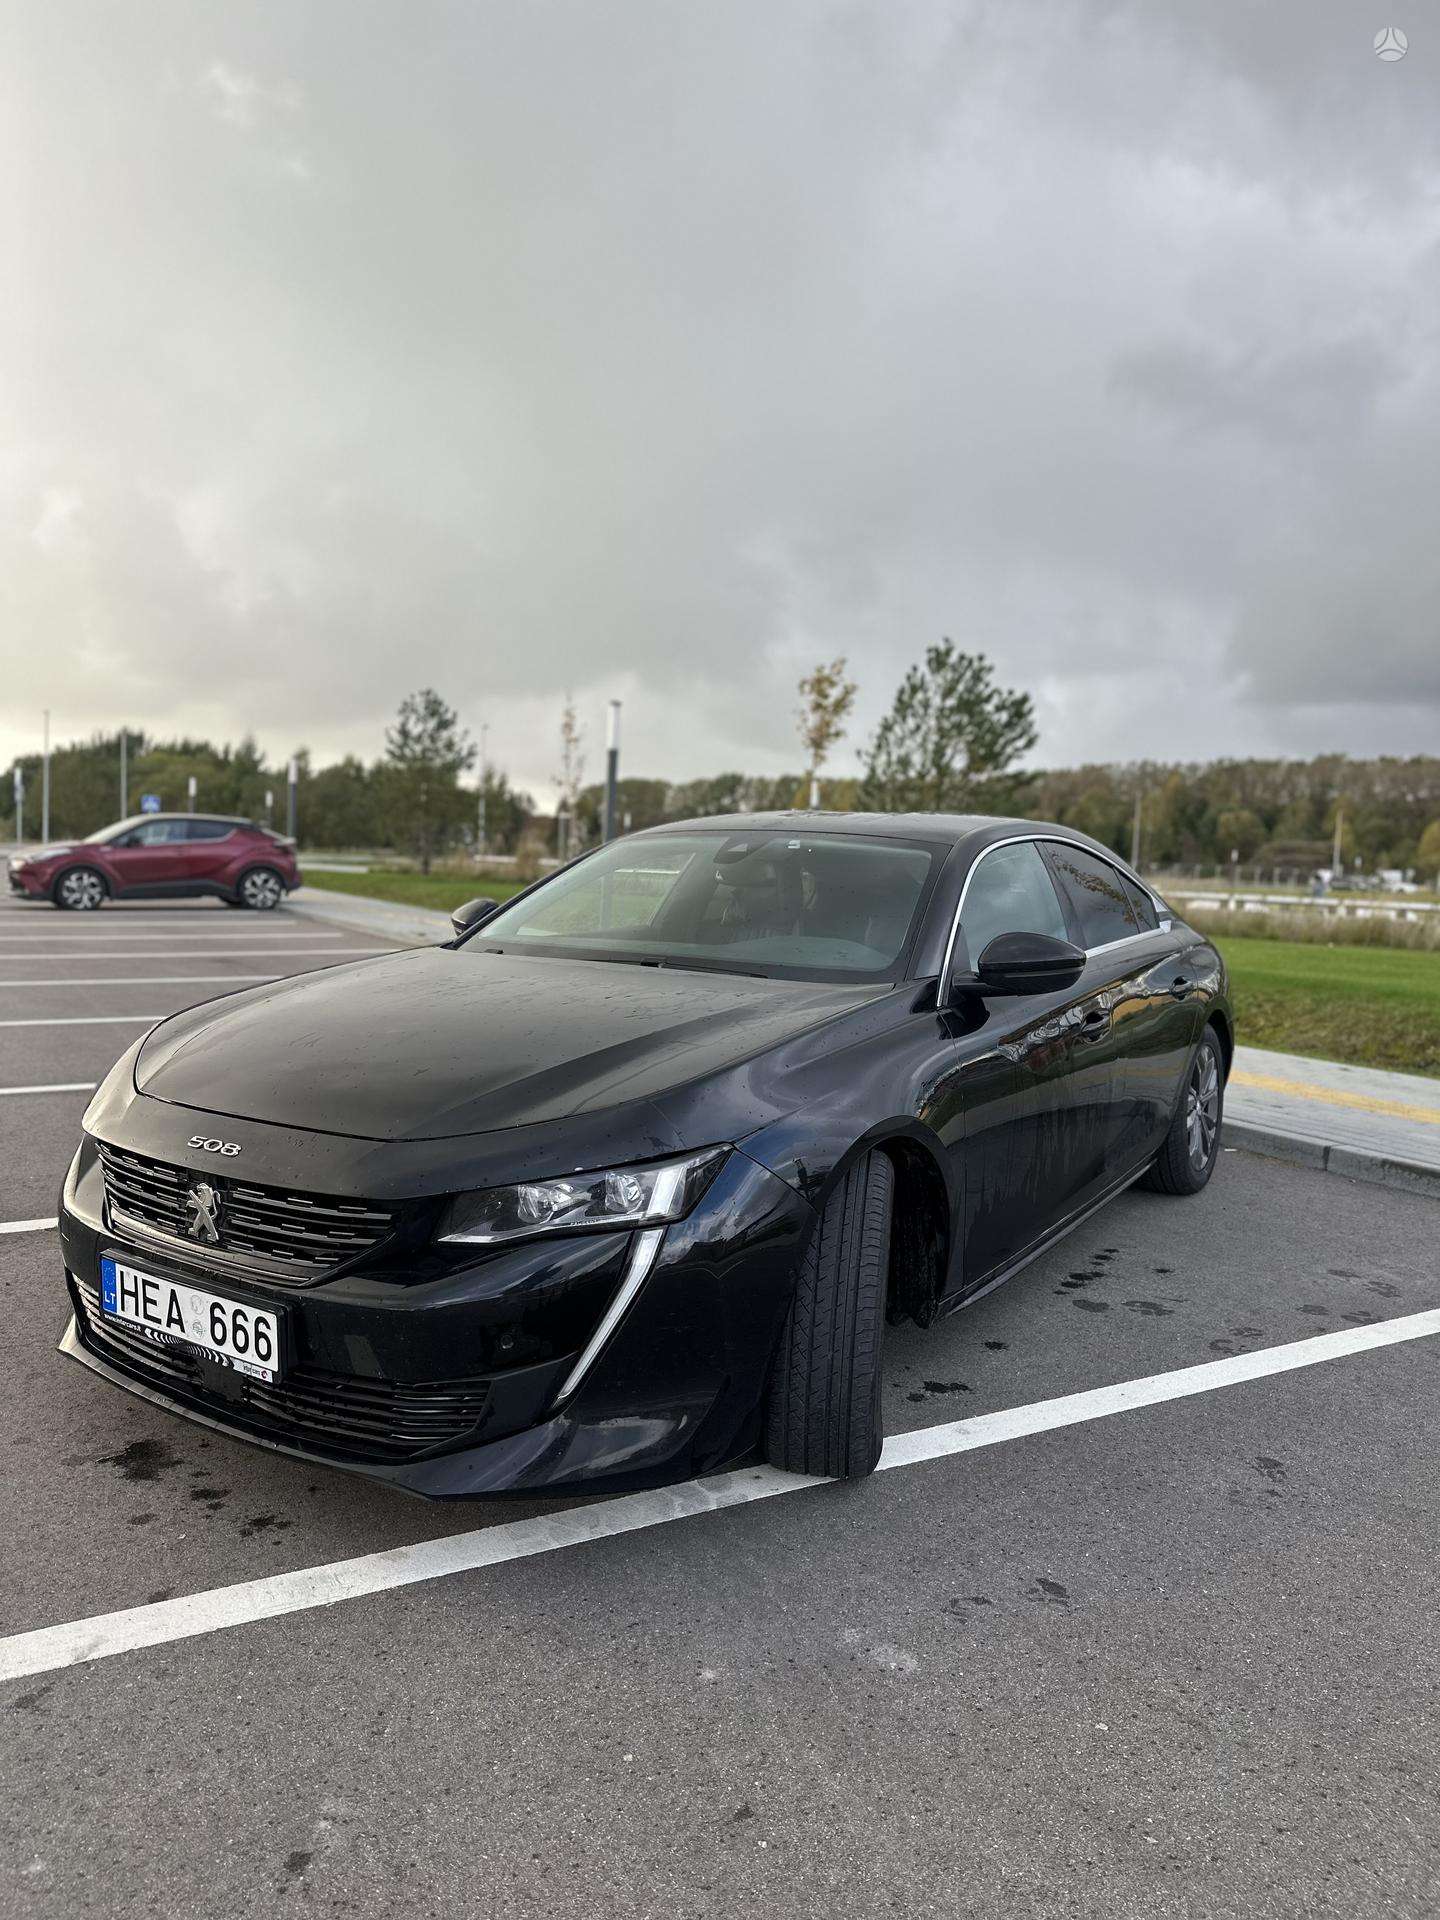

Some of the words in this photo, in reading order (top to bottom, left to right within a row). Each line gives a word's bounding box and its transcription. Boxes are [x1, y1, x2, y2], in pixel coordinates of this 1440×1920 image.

[187, 1135, 241, 1156] 508
[104, 1291, 116, 1305] LT
[119, 1270, 186, 1334] HEA
[209, 1301, 272, 1362] 666
